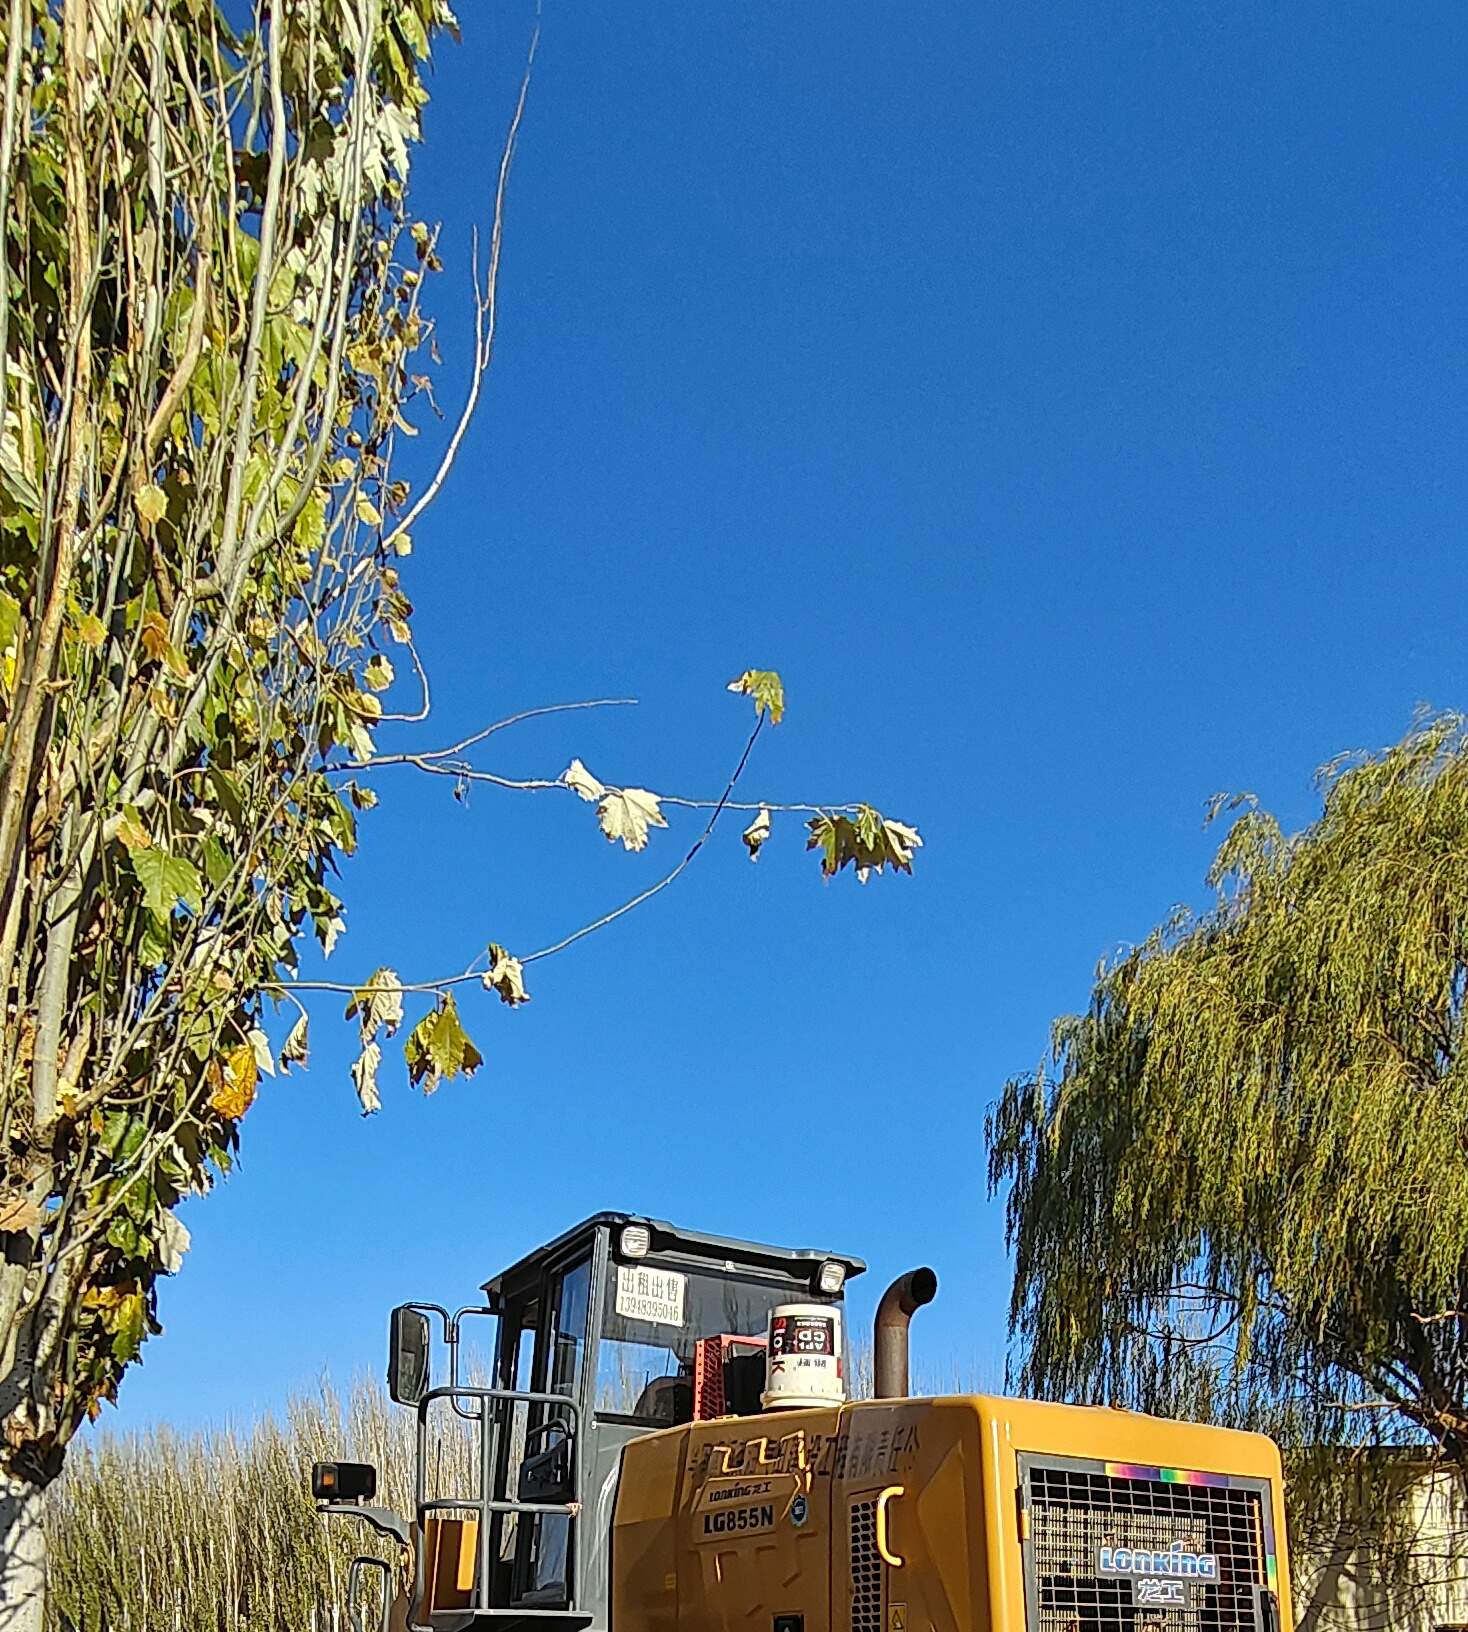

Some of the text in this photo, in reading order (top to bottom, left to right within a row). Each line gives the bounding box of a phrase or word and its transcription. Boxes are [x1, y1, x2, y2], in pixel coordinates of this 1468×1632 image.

[621, 1268, 679, 1302] 出租出售
[703, 1505, 774, 1534] LG855N
[1138, 1579, 1184, 1603] 龙工
